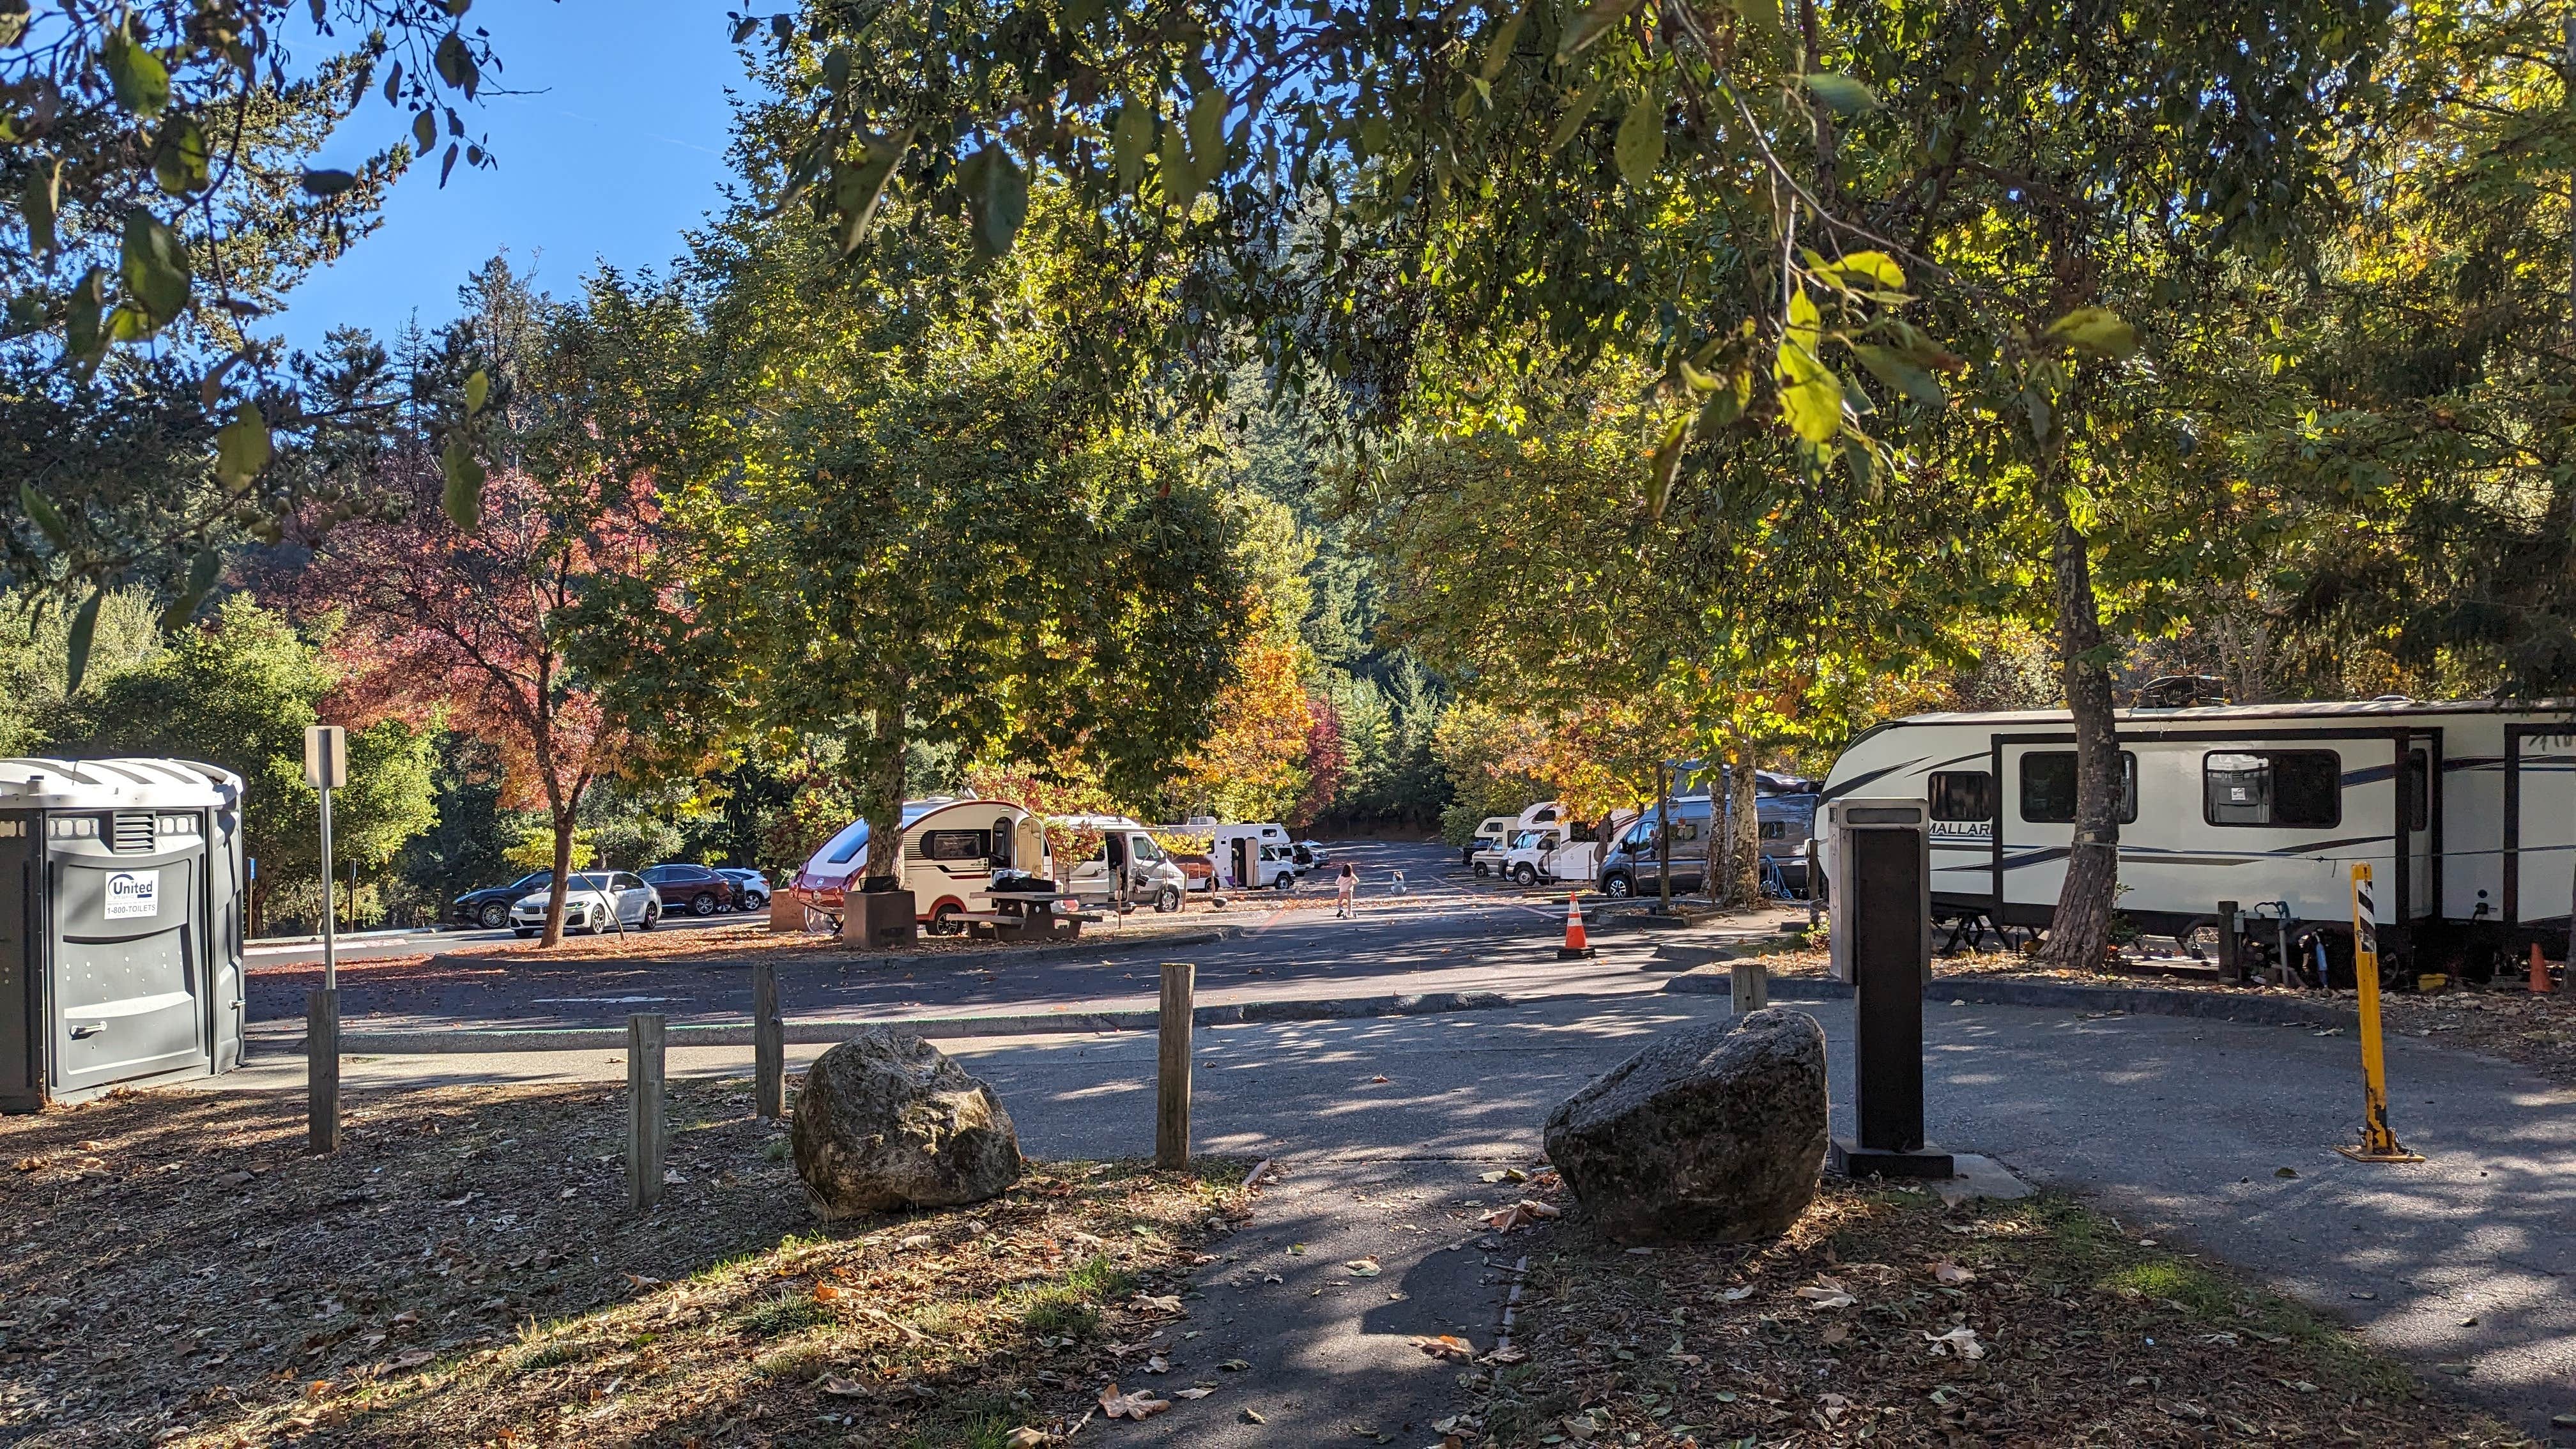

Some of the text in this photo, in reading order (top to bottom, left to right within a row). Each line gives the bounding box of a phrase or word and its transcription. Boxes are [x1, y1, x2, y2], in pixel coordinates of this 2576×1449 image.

[1929, 823, 1992, 835] MALLAR
[113, 880, 153, 894] United
[107, 904, 156, 914] 1-800-TOILETS
